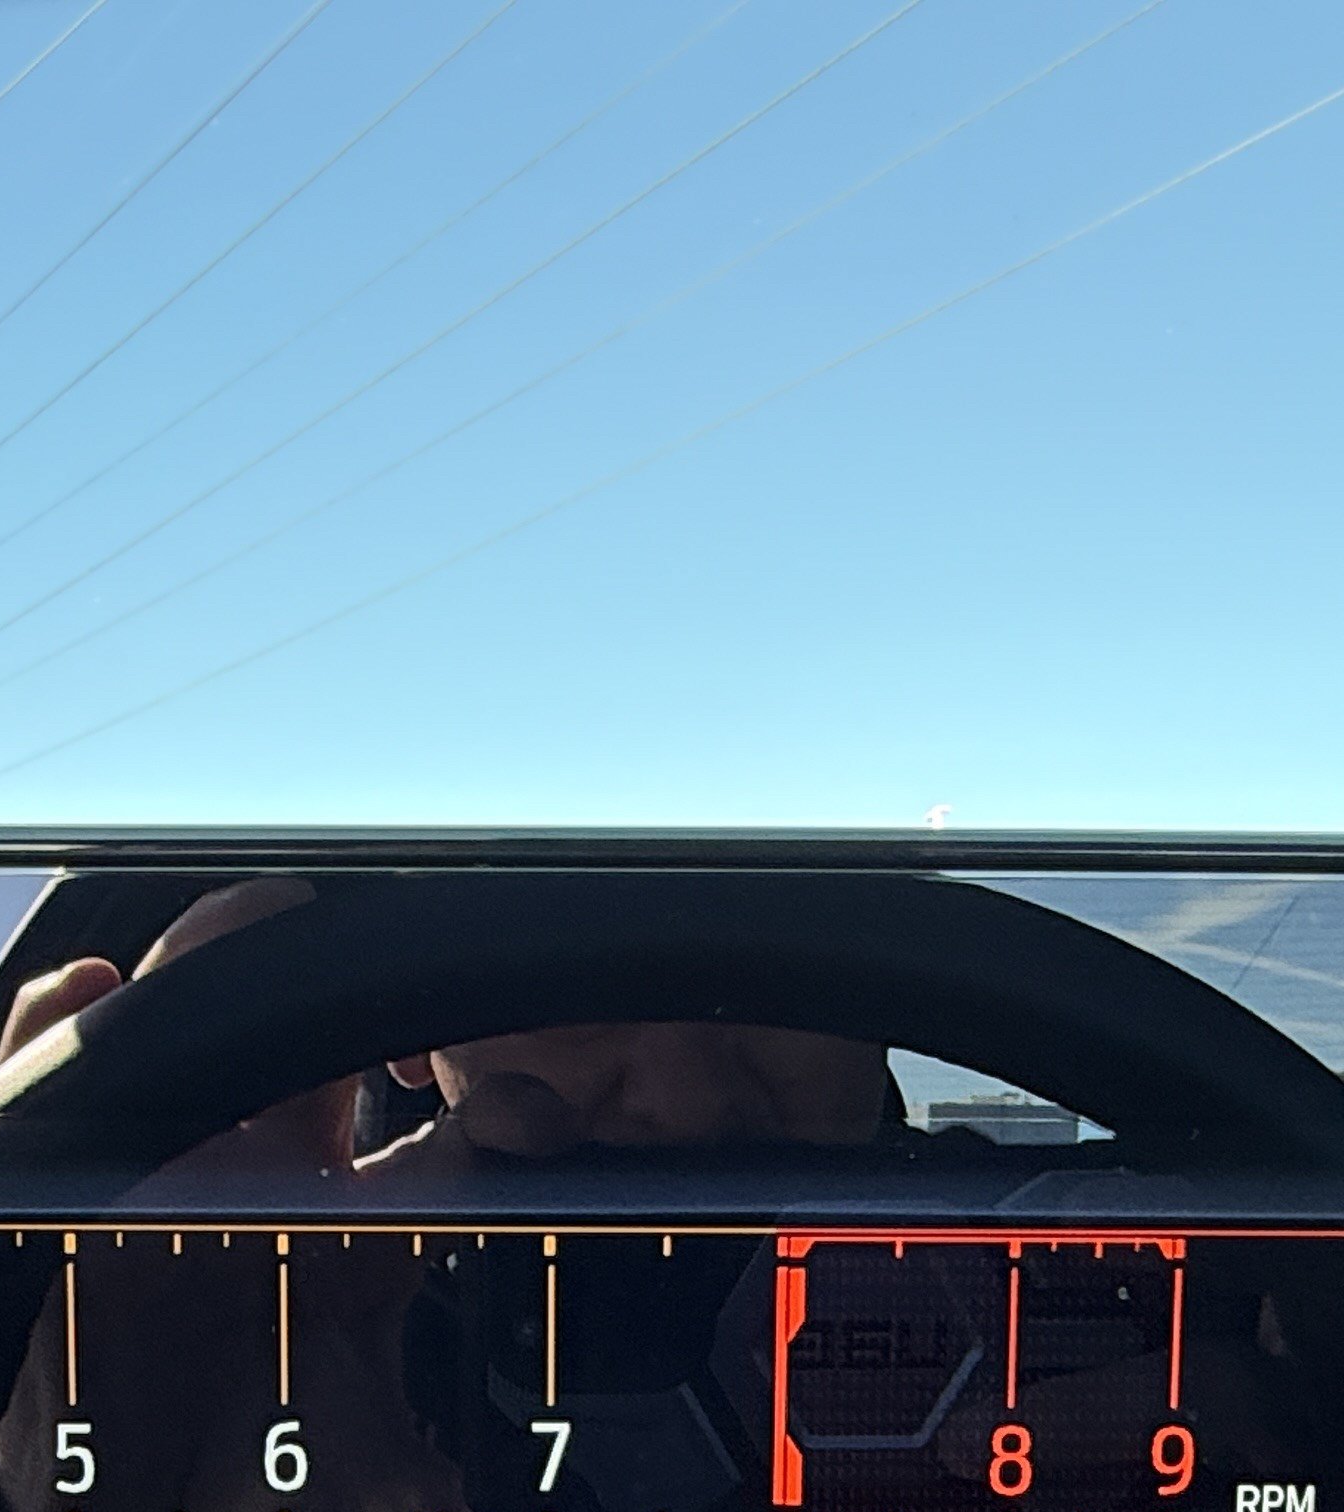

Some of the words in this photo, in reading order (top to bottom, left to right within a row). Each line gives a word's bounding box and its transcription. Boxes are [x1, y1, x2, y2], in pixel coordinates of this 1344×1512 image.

[56, 1423, 95, 1493] 5
[264, 1421, 308, 1492] 6
[531, 1421, 571, 1492] 7
[989, 1425, 1033, 1496] 8
[1151, 1425, 1195, 1496] 9
